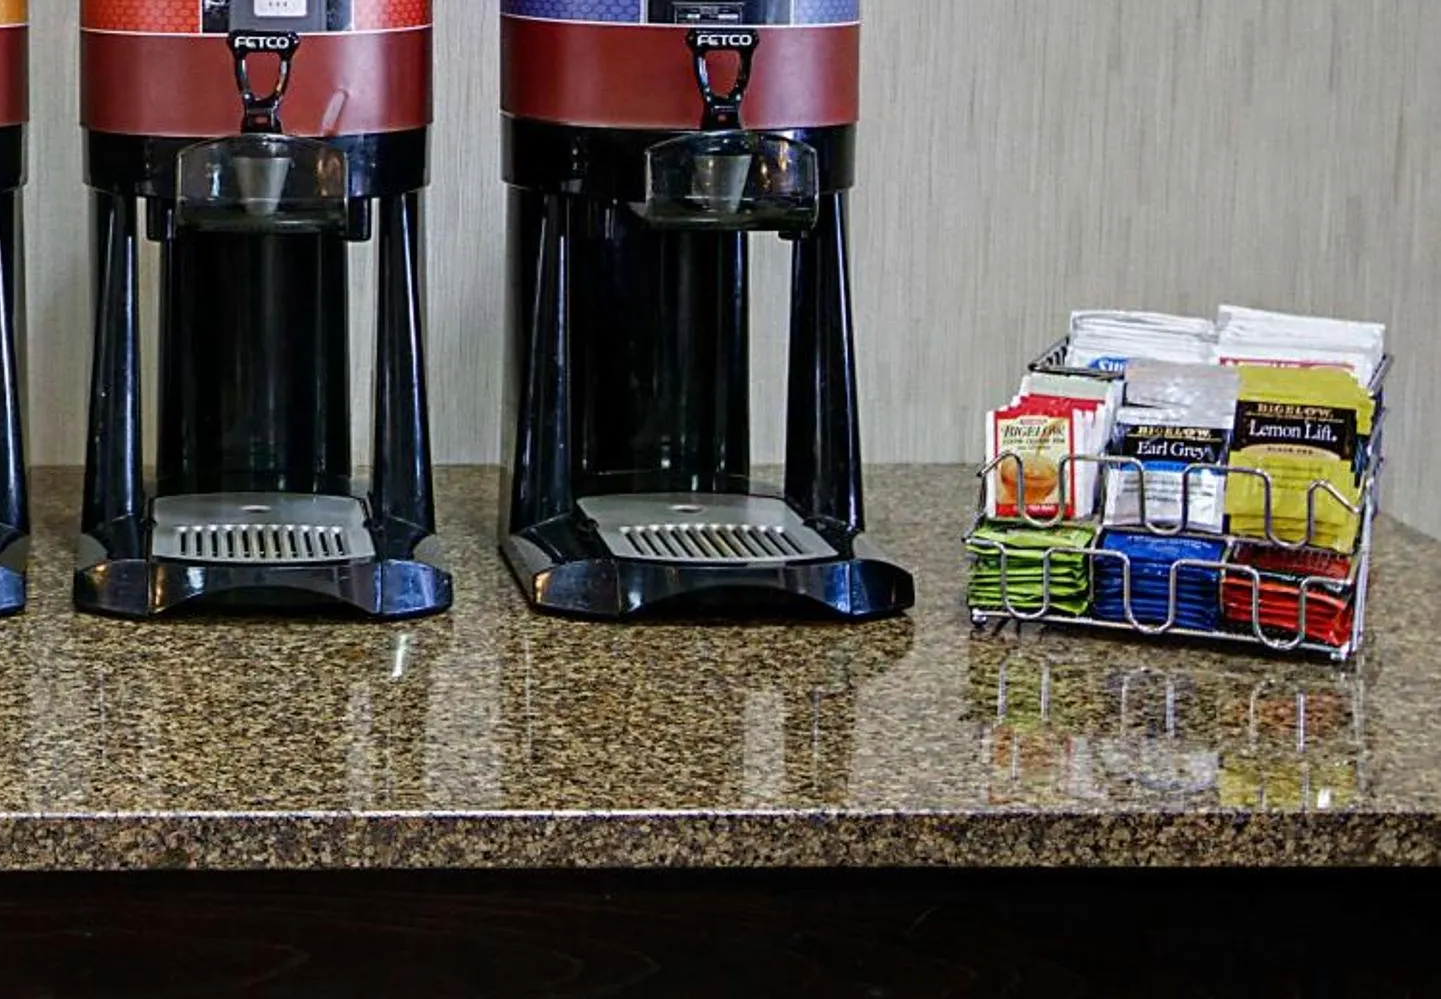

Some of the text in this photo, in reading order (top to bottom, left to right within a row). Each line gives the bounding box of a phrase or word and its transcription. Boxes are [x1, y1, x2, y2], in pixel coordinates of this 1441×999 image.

[234, 36, 289, 49] FETCO
[696, 34, 753, 46] FETCO
[1257, 403, 1334, 419] BIGELOW
[1249, 419, 1301, 438] Lemon
[1137, 441, 1204, 460] Earl Grey
